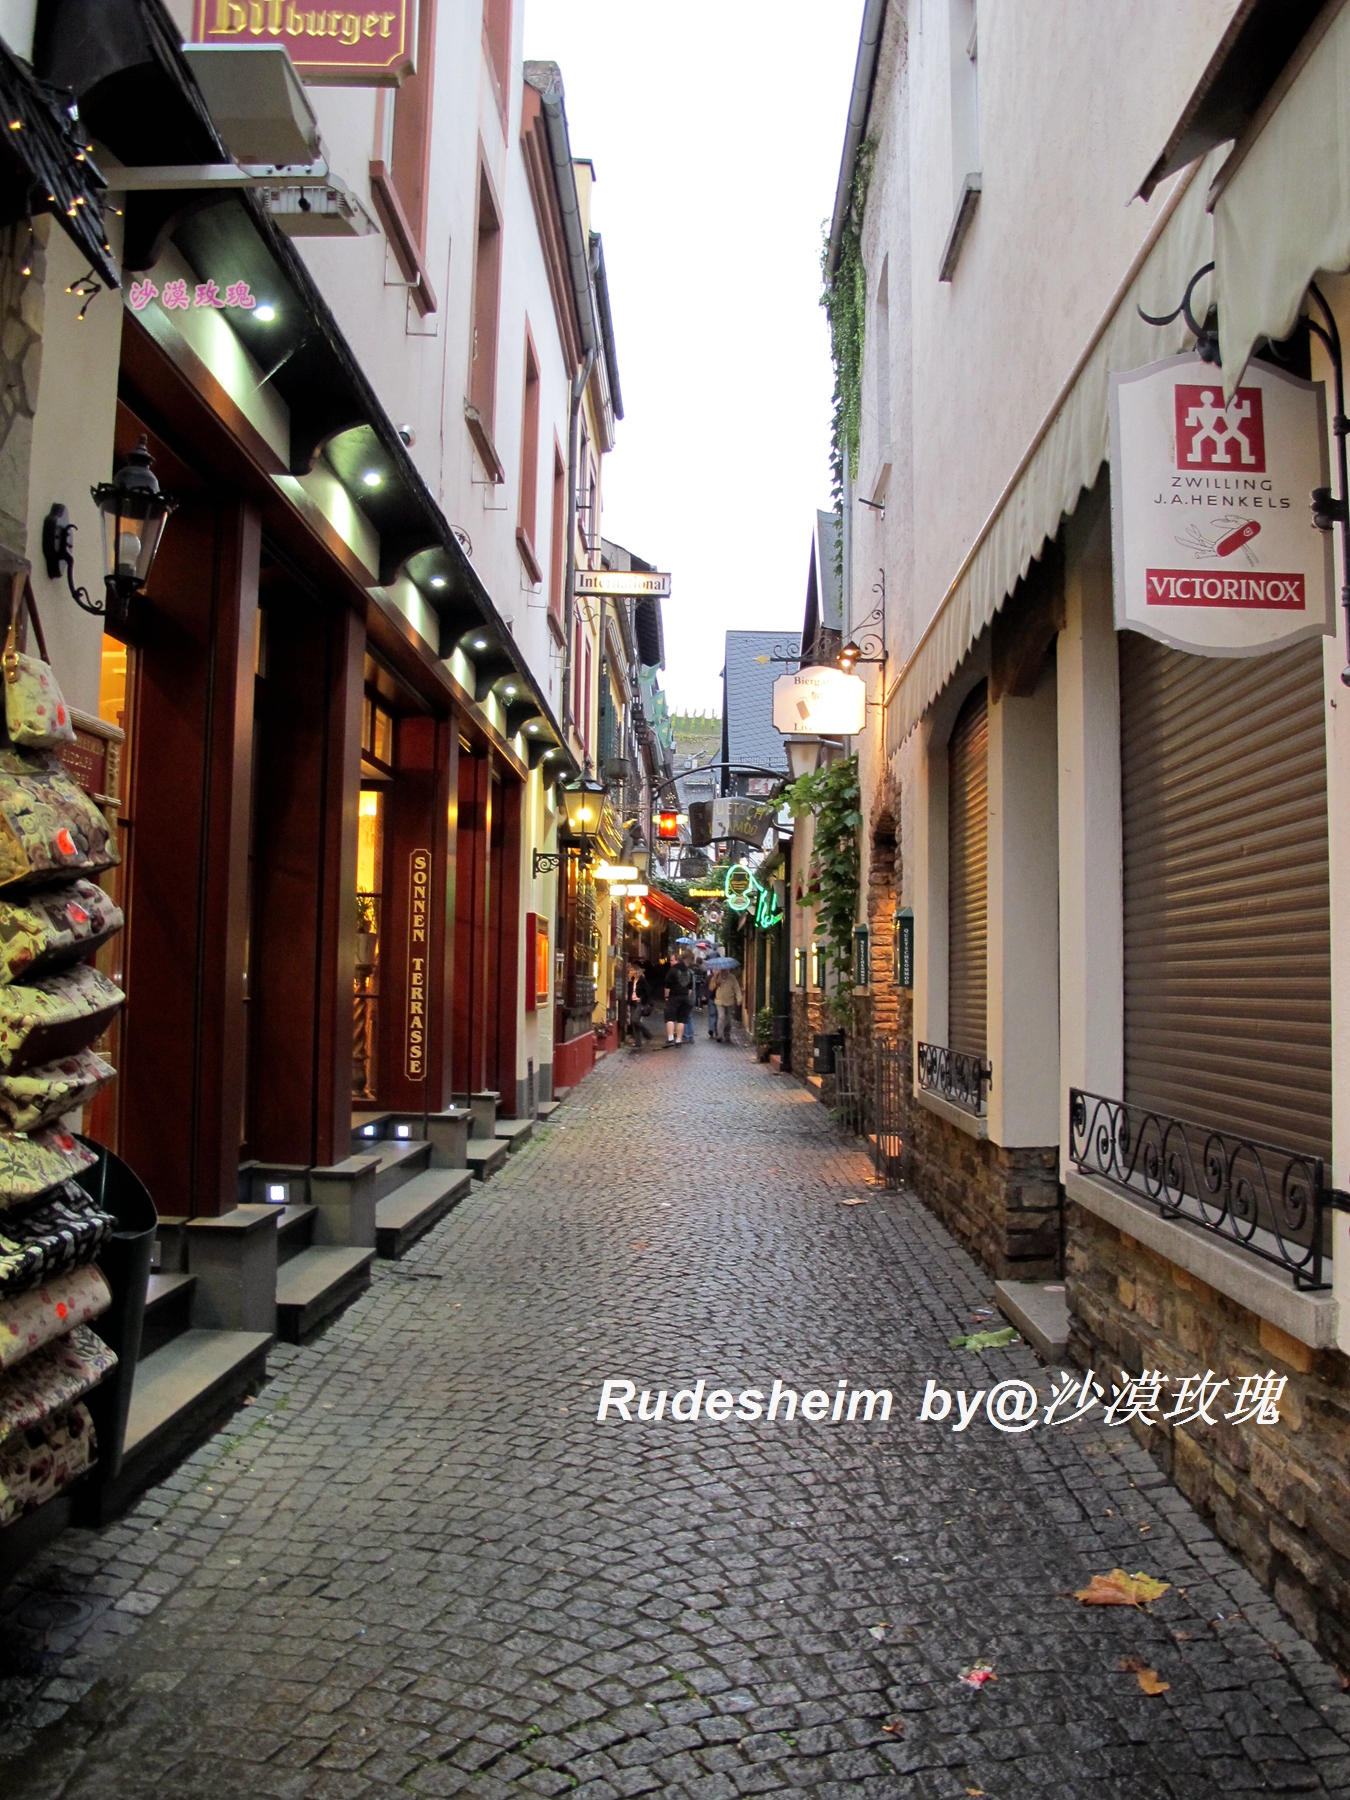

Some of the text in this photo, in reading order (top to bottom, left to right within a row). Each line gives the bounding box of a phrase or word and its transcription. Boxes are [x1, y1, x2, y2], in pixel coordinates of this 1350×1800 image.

[1171, 476, 1273, 491] ZWILLING
[1154, 494, 1291, 509] J.A.HENKELS
[1150, 576, 1300, 602] VICTORINOX
[409, 856, 427, 1074] SONNEN TERRASSE
